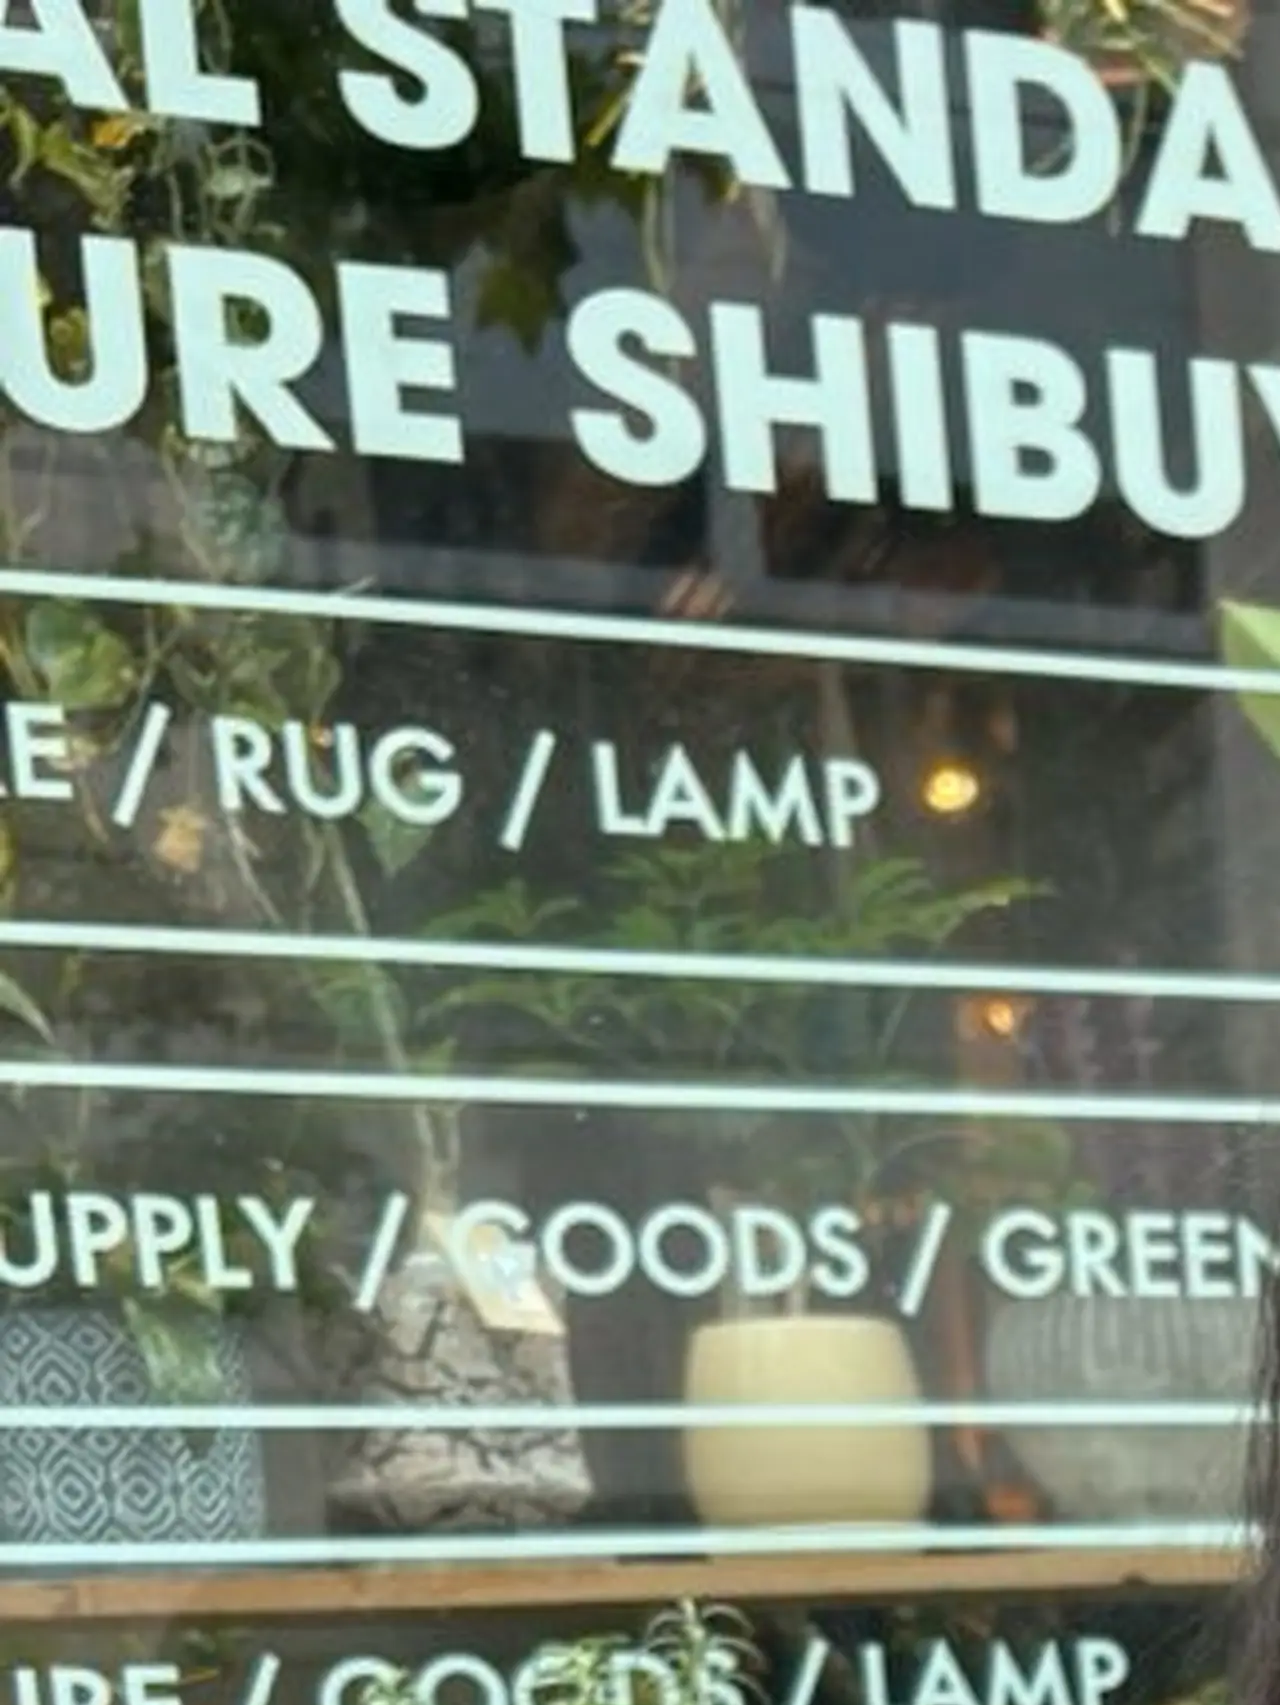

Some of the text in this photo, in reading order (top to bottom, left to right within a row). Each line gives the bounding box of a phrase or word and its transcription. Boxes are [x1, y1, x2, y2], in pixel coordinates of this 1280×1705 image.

[0, 227, 464, 463] URE
[0, 702, 74, 799] E
[211, 714, 463, 825] RUG
[592, 741, 880, 849] LAMP
[0, 1190, 314, 1290] UPPLY
[449, 1200, 869, 1297] GOODS
